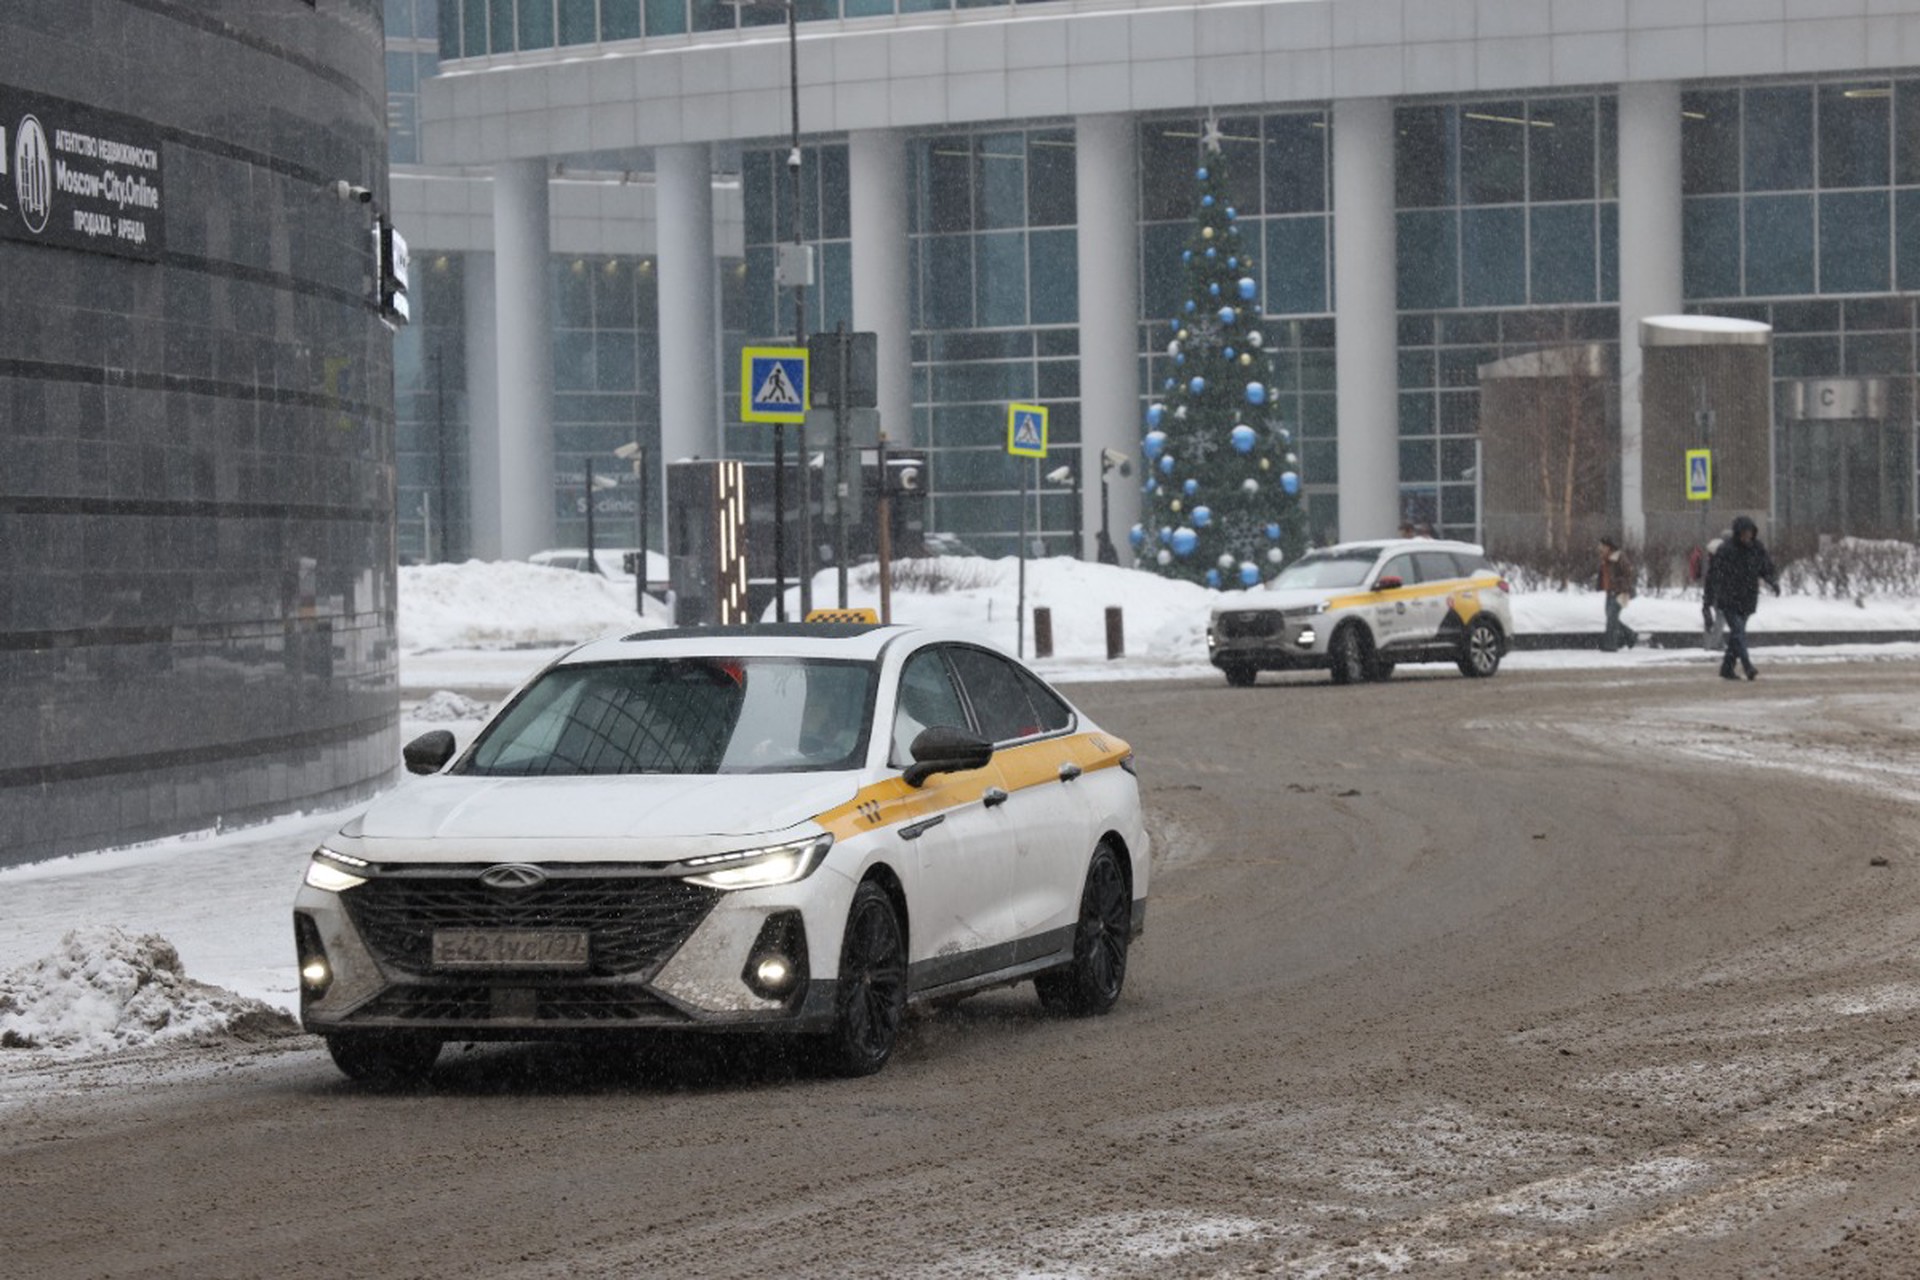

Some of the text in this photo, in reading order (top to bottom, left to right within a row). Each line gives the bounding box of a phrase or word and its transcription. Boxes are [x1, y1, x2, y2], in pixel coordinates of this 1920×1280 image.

[55, 129, 158, 170] АГЕНТСТВО НЕДВИЖИМОСТИ
[56, 159, 159, 210] Moscow-City.Online
[73, 210, 147, 244] ПРОДАЖА АРЕНДА
